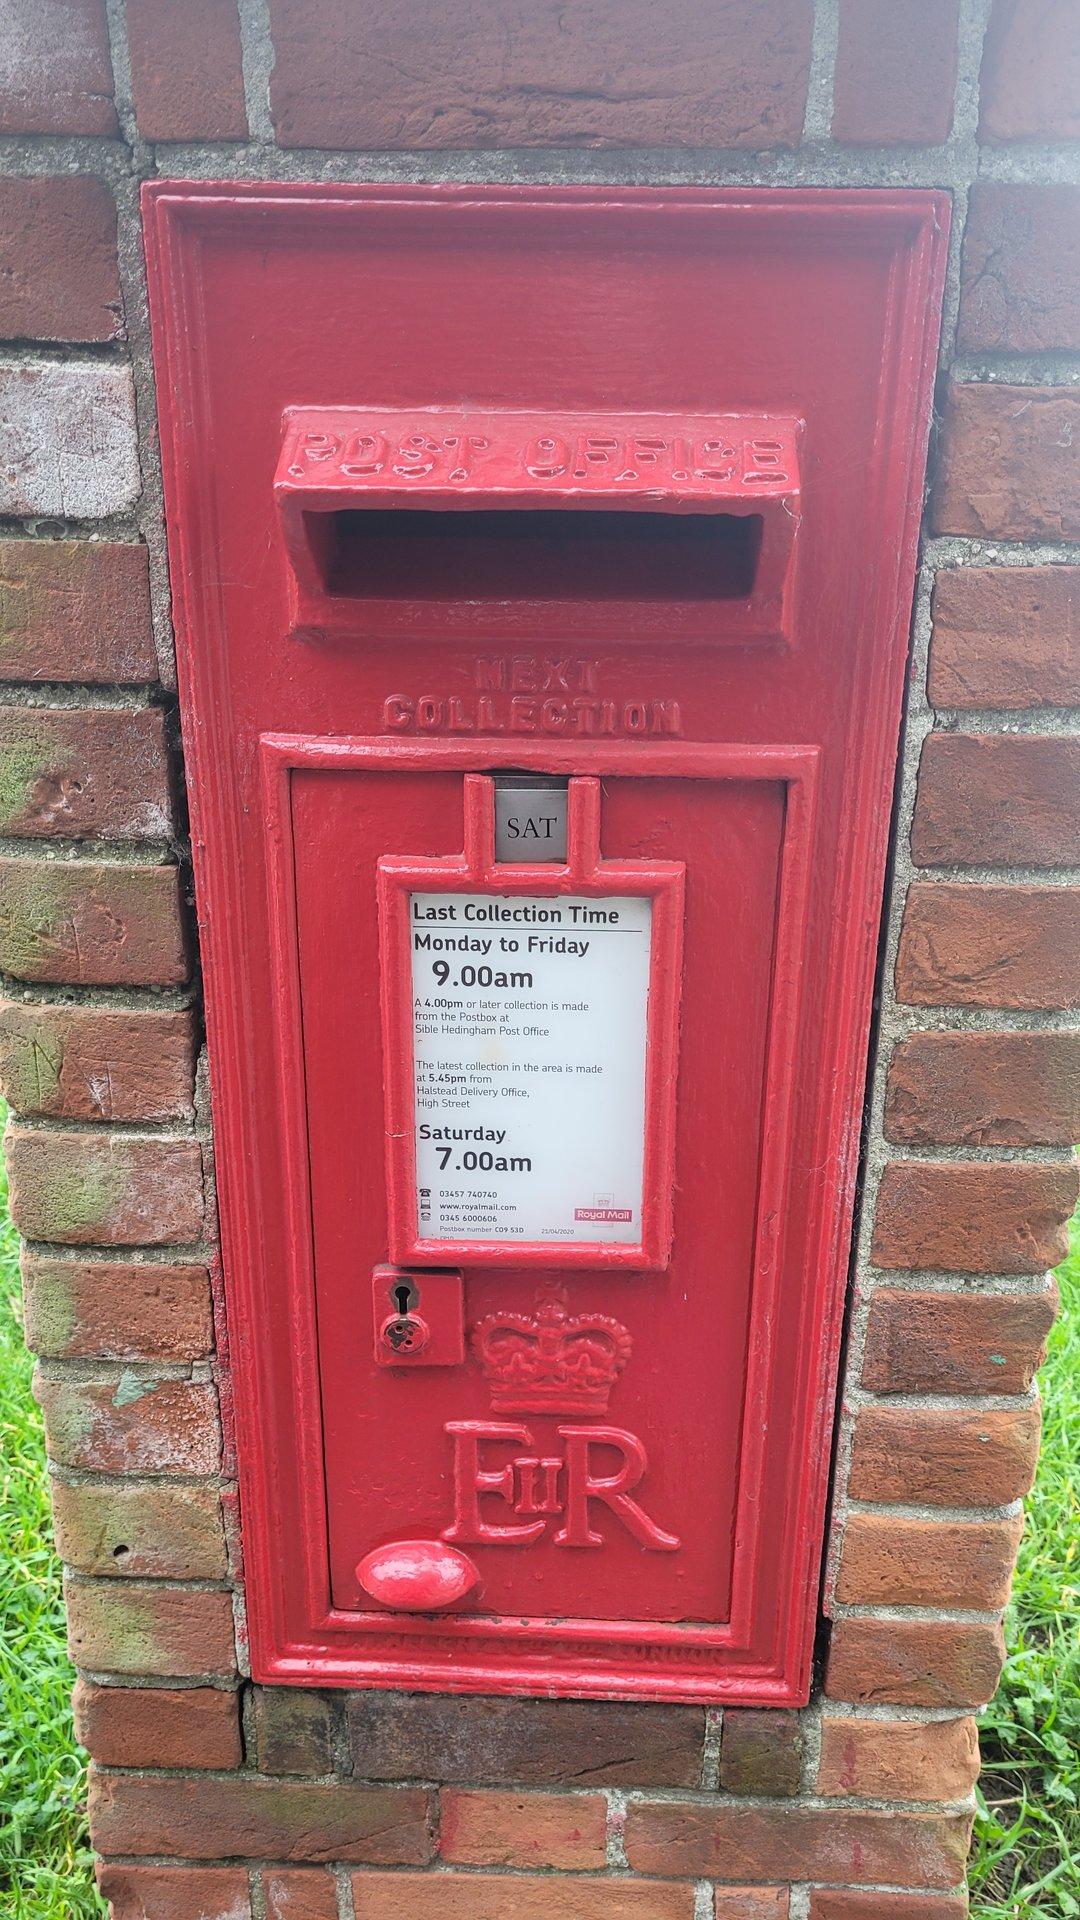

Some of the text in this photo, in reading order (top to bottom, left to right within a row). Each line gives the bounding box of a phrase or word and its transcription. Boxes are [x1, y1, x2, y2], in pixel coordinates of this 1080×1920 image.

[286, 434, 788, 486] POST OFFICE
[476, 657, 601, 693] NEXT
[383, 694, 681, 735] COLLECTION
[507, 817, 558, 839] SAT
[414, 903, 619, 923] Last Collection Time
[415, 933, 589, 957] Monday to Friday
[432, 960, 532, 988] 9.00am
[415, 999, 422, 1007] A
[425, 999, 462, 1009] 4.00pm
[480, 1000, 501, 1009] later
[504, 1001, 548, 1010] collection
[552, 1001, 558, 1010] is
[562, 1002, 588, 1011] made
[415, 1012, 509, 1022] from the Postbox at
[415, 1025, 549, 1036] Sible Hedingham Post Office
[417, 1061, 434, 1070] The
[438, 1061, 463, 1070] latest
[466, 1062, 508, 1071] collection
[512, 1063, 520, 1071] in
[524, 1063, 538, 1072] the
[566, 1064, 573, 1072] is
[576, 1065, 602, 1073] made
[429, 1074, 466, 1084] 5.45pm
[470, 1074, 491, 1083] from
[417, 1086, 529, 1098] Halstead Delivery Office,
[417, 1098, 470, 1109] High Street
[420, 1125, 506, 1144] Saturday
[436, 1147, 531, 1171] 7.00am
[440, 1203, 517, 1212] www.royalmail.com
[577, 1209, 630, 1220] Royal Mail
